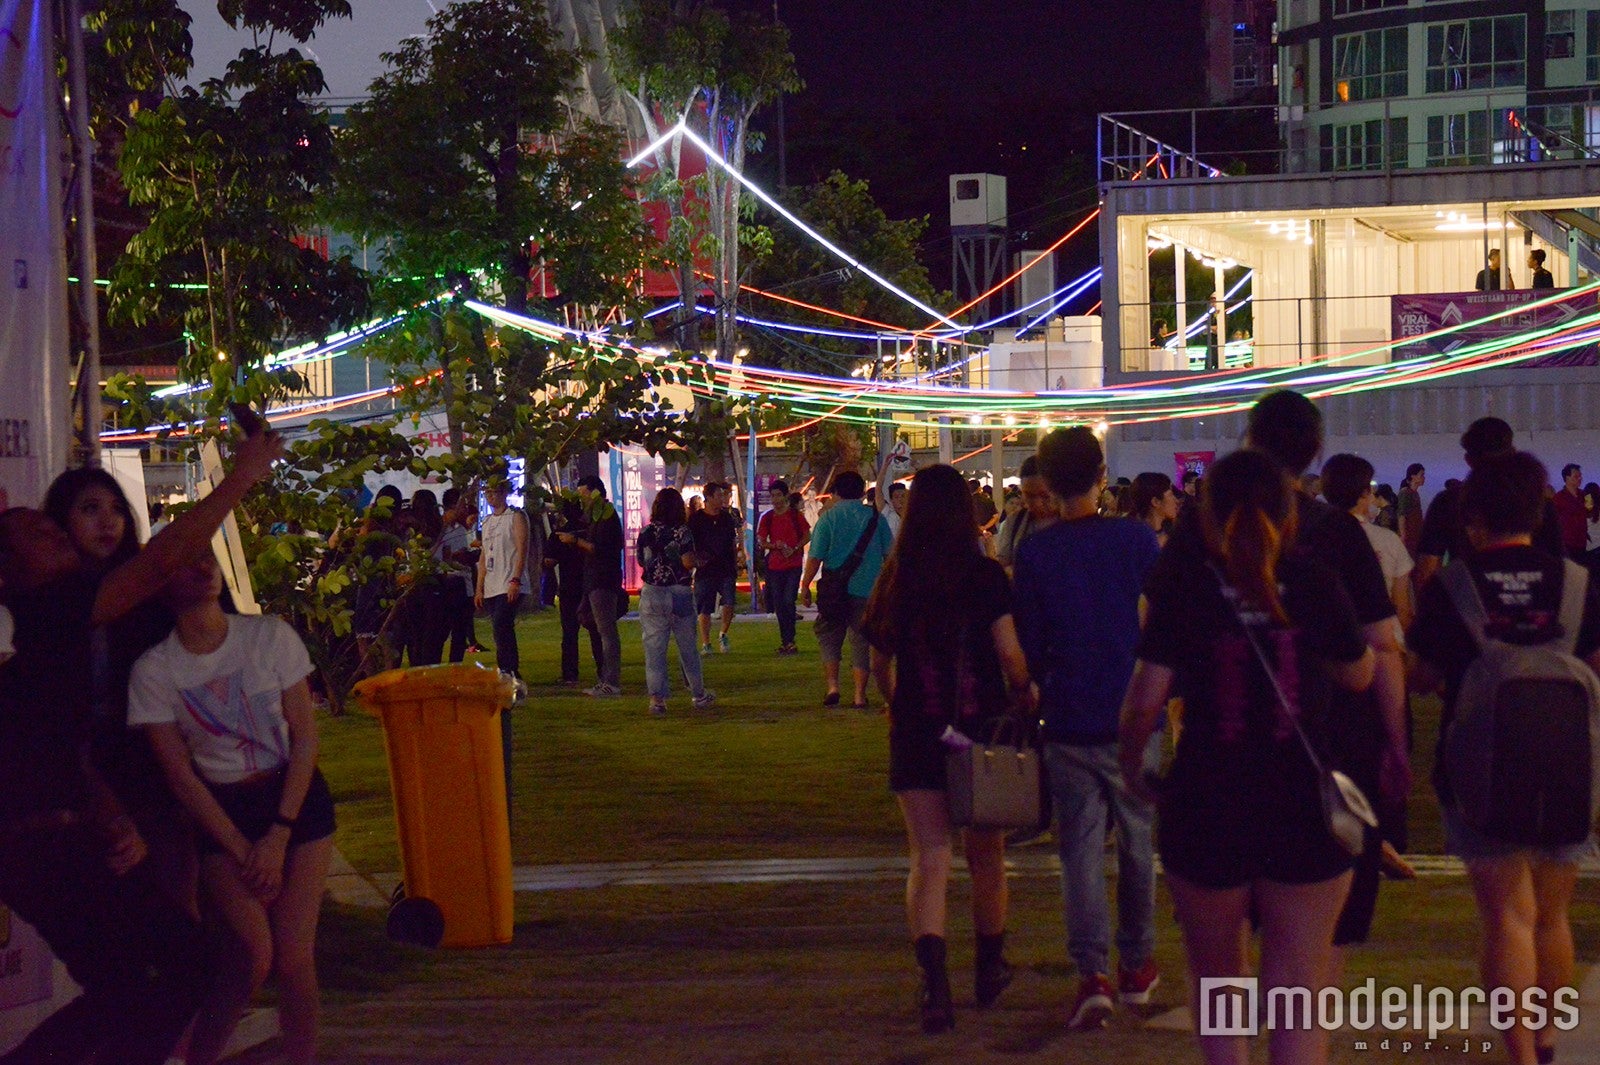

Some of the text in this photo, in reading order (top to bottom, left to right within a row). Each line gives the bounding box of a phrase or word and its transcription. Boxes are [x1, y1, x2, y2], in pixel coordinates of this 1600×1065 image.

[1399, 314, 1430, 325] VIRAL
[1402, 324, 1428, 336] FEST
[624, 471, 643, 491] VIRAL
[626, 490, 642, 510] FEST
[626, 510, 643, 530] ASIA
